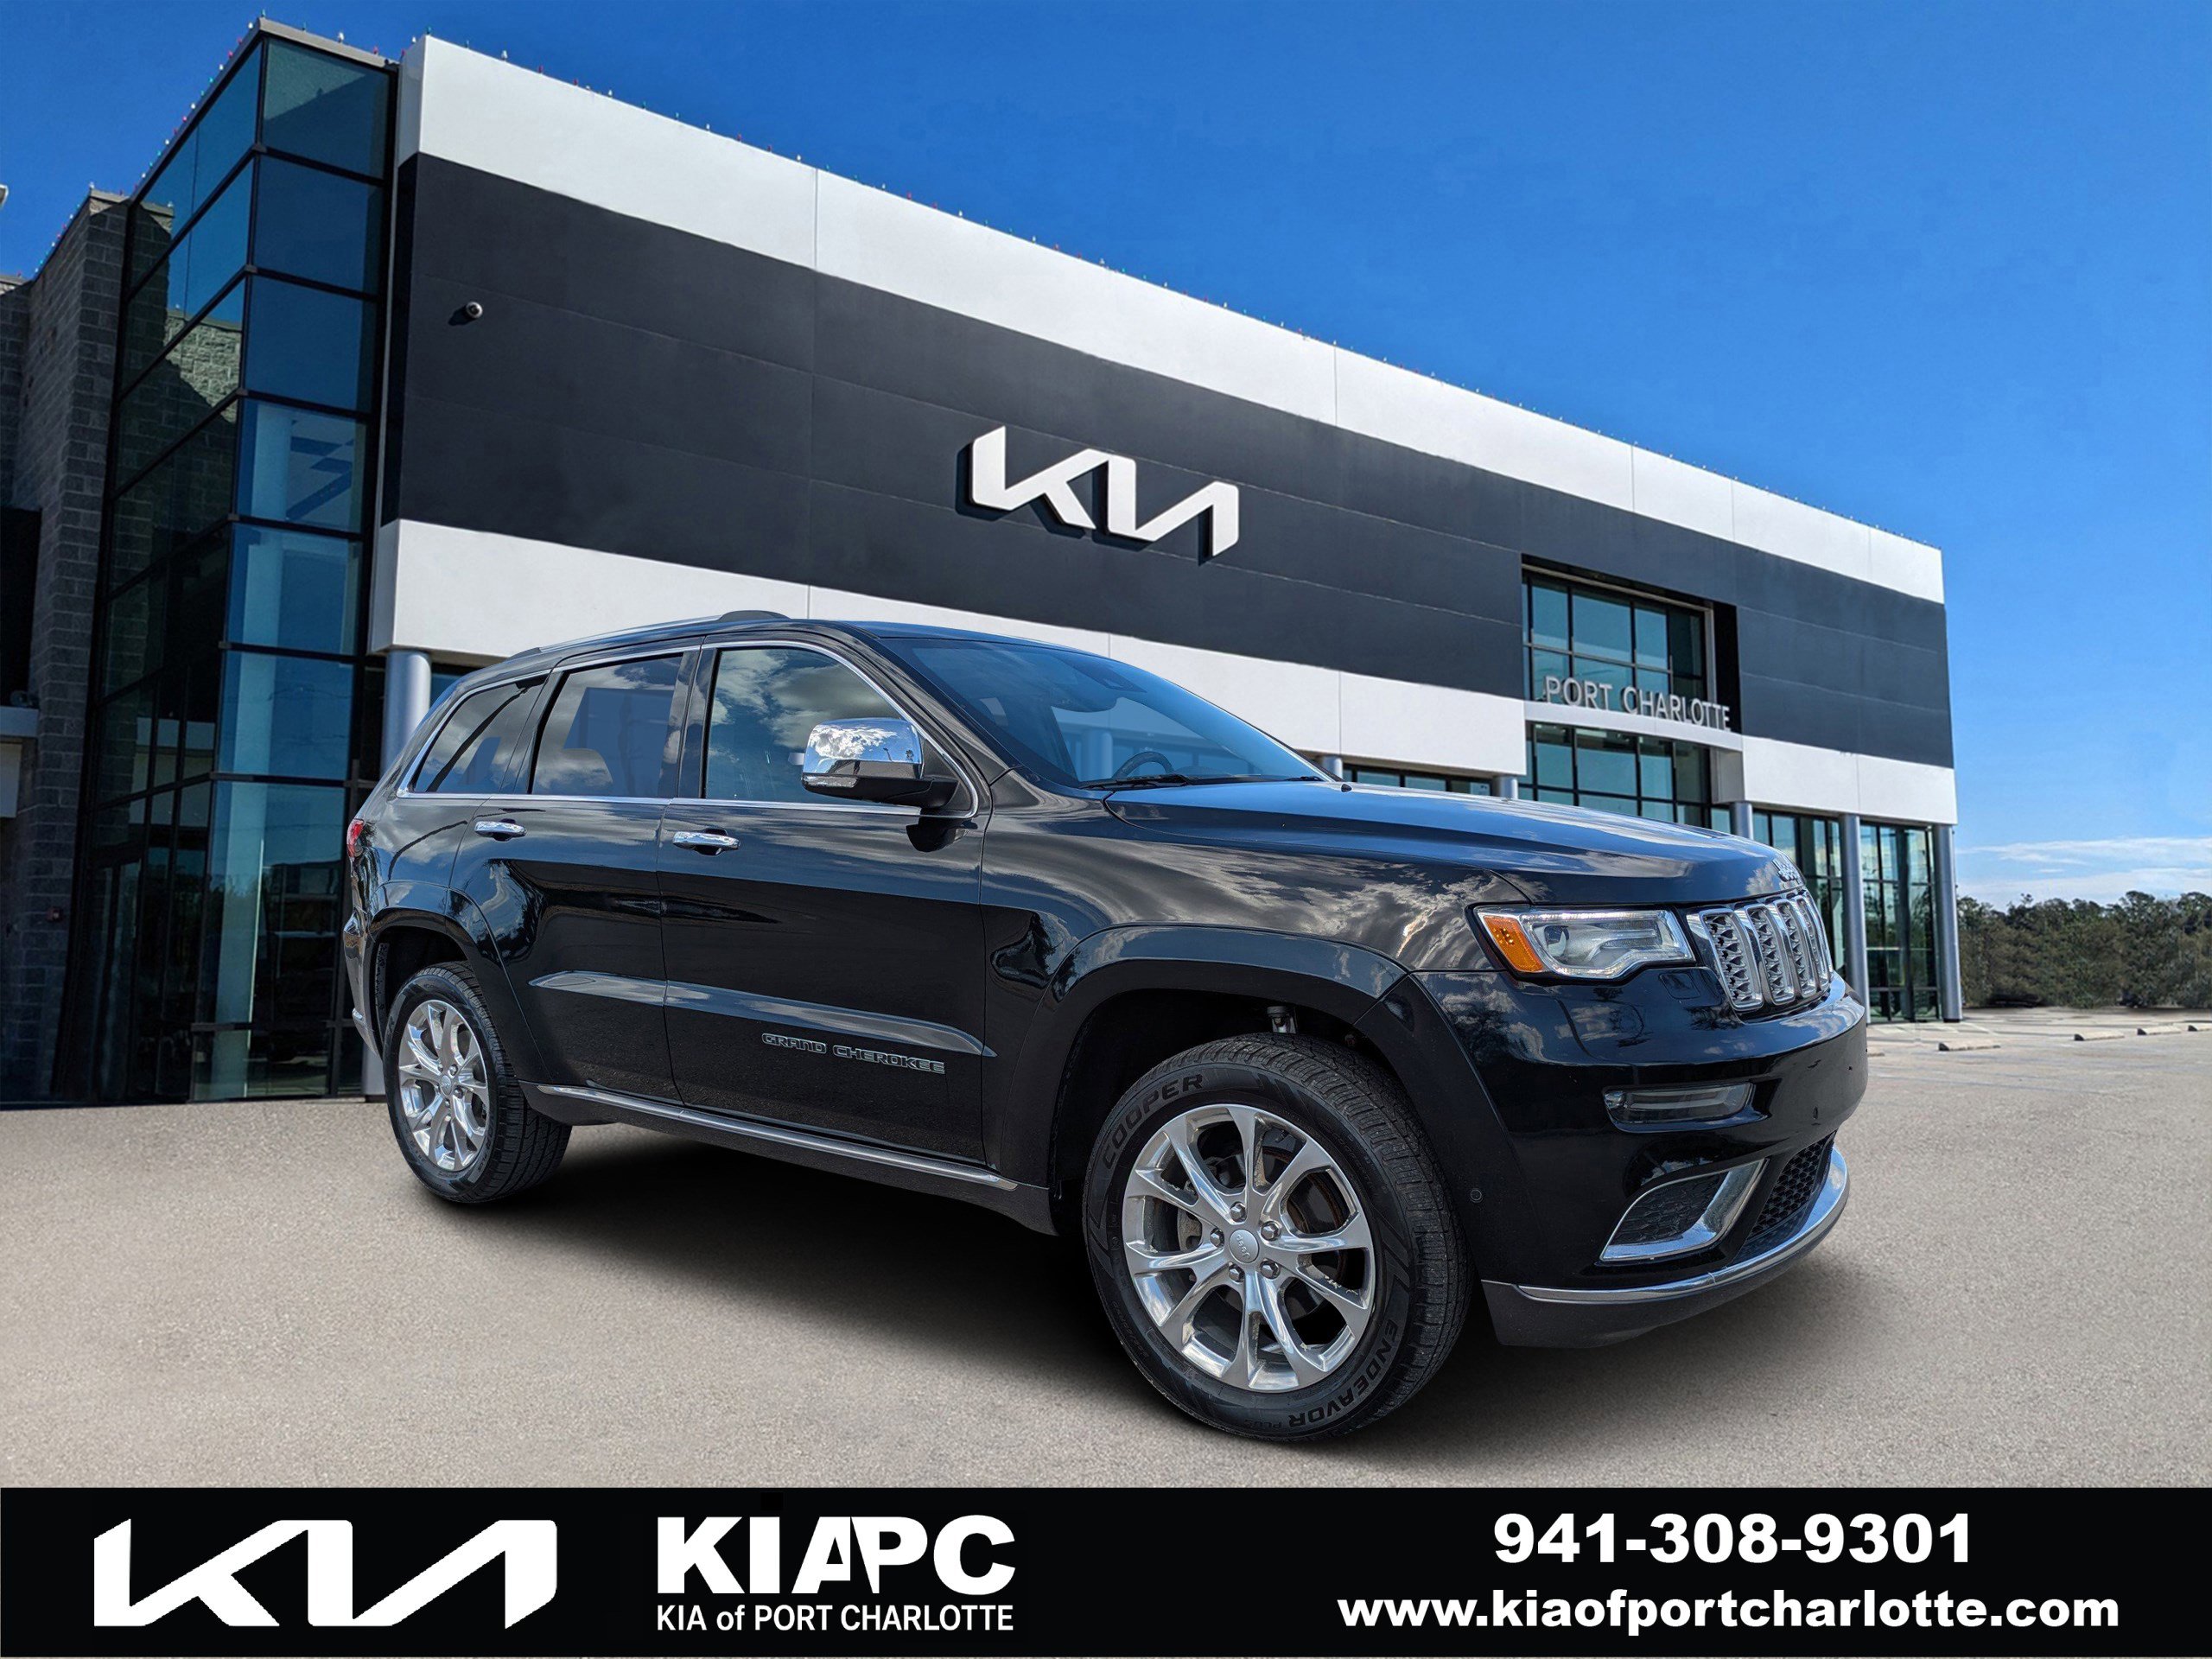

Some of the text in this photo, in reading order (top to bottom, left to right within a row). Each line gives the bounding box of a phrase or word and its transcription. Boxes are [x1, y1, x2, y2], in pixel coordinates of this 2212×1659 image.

[972, 426, 1239, 557] KIA
[1545, 676, 1731, 732] PORT CHARLOTTE
[761, 1033, 945, 1074] GRAND CHEROKEE
[1103, 1073, 1203, 1170] COOPER
[1287, 1319, 1399, 1427] ENDEAVOR
